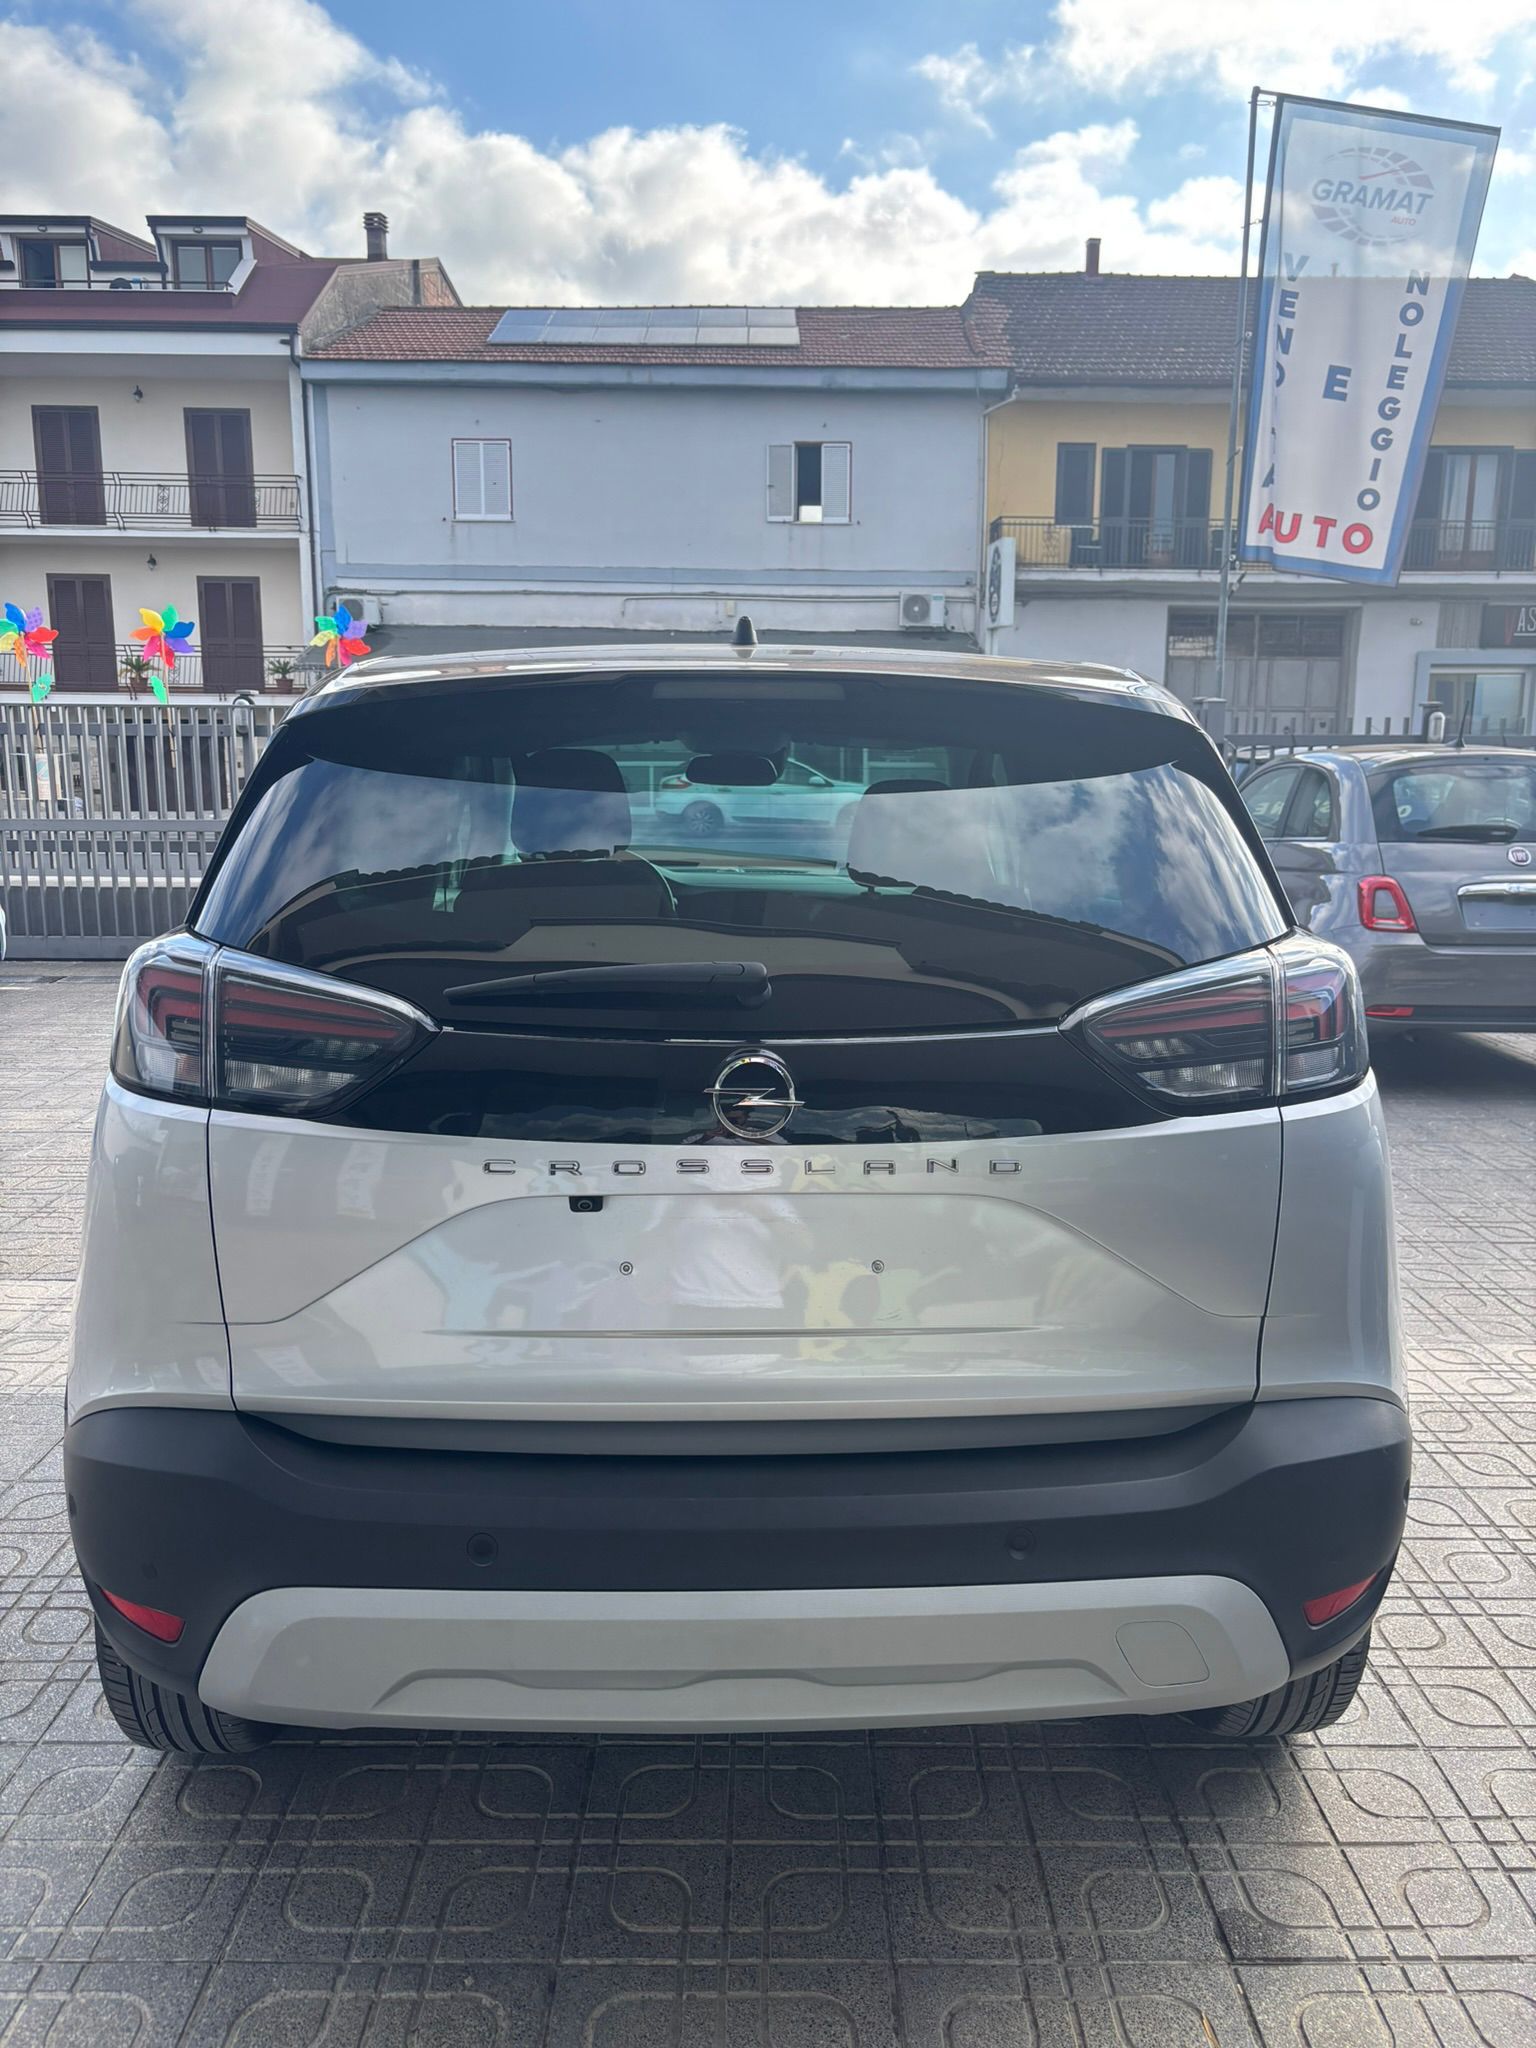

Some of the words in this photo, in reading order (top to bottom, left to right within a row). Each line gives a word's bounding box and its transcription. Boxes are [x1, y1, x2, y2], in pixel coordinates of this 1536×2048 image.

[1311, 177, 1435, 215] GRAMAT
[1391, 215, 1417, 226] AUTO
[1322, 364, 1353, 402] E
[1357, 268, 1431, 512] NOLEGGIO
[1258, 502, 1374, 555] AUTO
[482, 1157, 1023, 1177] CROSSLAND
